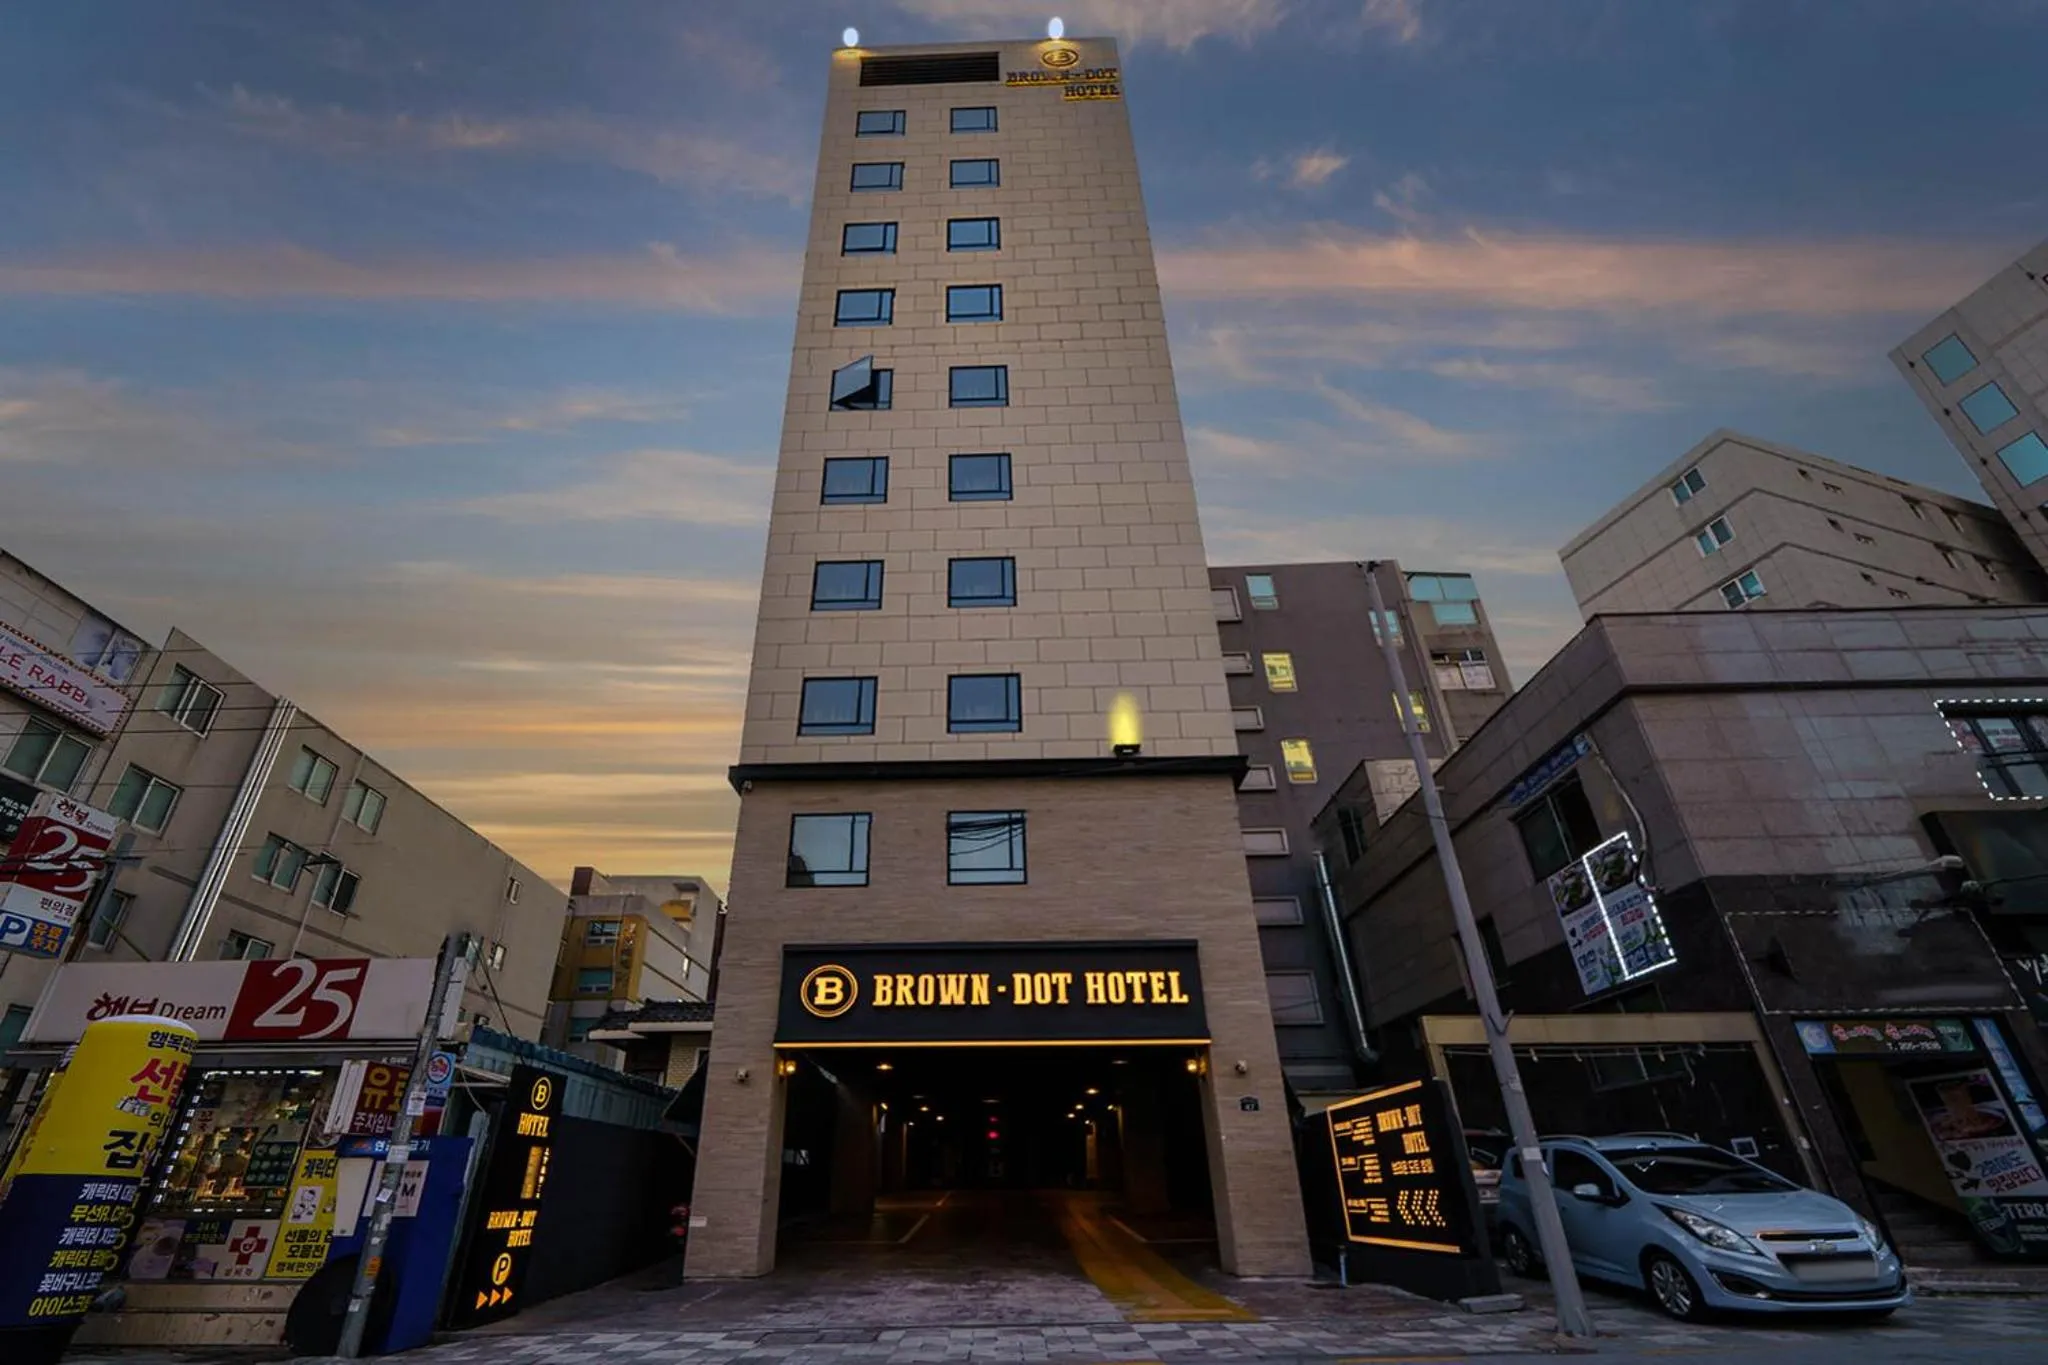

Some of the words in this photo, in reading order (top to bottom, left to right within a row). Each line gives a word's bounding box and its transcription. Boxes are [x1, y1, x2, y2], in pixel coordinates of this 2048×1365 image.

[1083, 67, 1118, 82] DOT
[1063, 85, 1121, 98] HOTEL
[27, 665, 90, 705] RABB
[56, 798, 89, 826] 행복
[25, 825, 107, 893] 25
[39, 896, 78, 918] 편의점
[1, 916, 28, 943] P
[31, 935, 59, 952] 주차
[252, 958, 363, 1040] 25
[814, 976, 844, 1005] B
[872, 973, 991, 1007] BROWN
[1012, 971, 1073, 1005] DOT
[1085, 970, 1190, 1004] HOTEL
[160, 1001, 227, 1021] Dream
[535, 1084, 548, 1104] B
[517, 1112, 550, 1138] HOTEL
[103, 1129, 150, 1169] 집
[79, 1183, 122, 1201] 캐릭터
[487, 1210, 519, 1230] BROWN
[1999, 1202, 2048, 1221] TERR
[58, 1227, 101, 1246] 캐릭터
[506, 1229, 533, 1248] HOTEL
